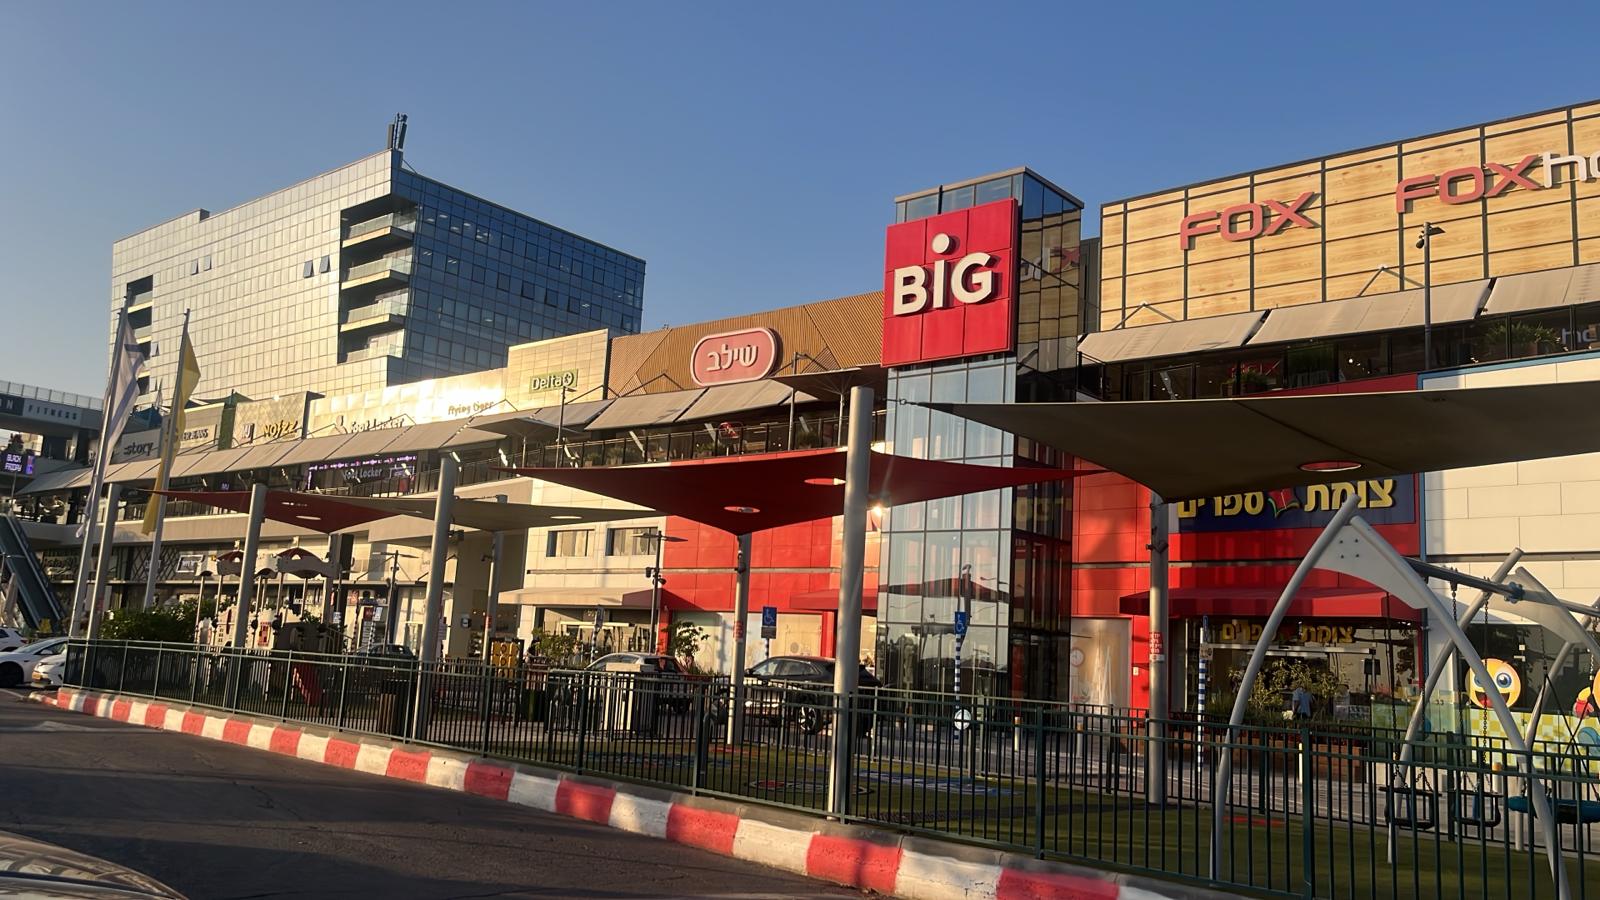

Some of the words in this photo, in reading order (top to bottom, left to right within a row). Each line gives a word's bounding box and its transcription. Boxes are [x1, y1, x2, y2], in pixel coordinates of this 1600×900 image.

[1180, 192, 1314, 250] FOX
[706, 344, 757, 372] שילב
[28, 404, 77, 420] FITNESS
[1304, 479, 1393, 511] צומת
